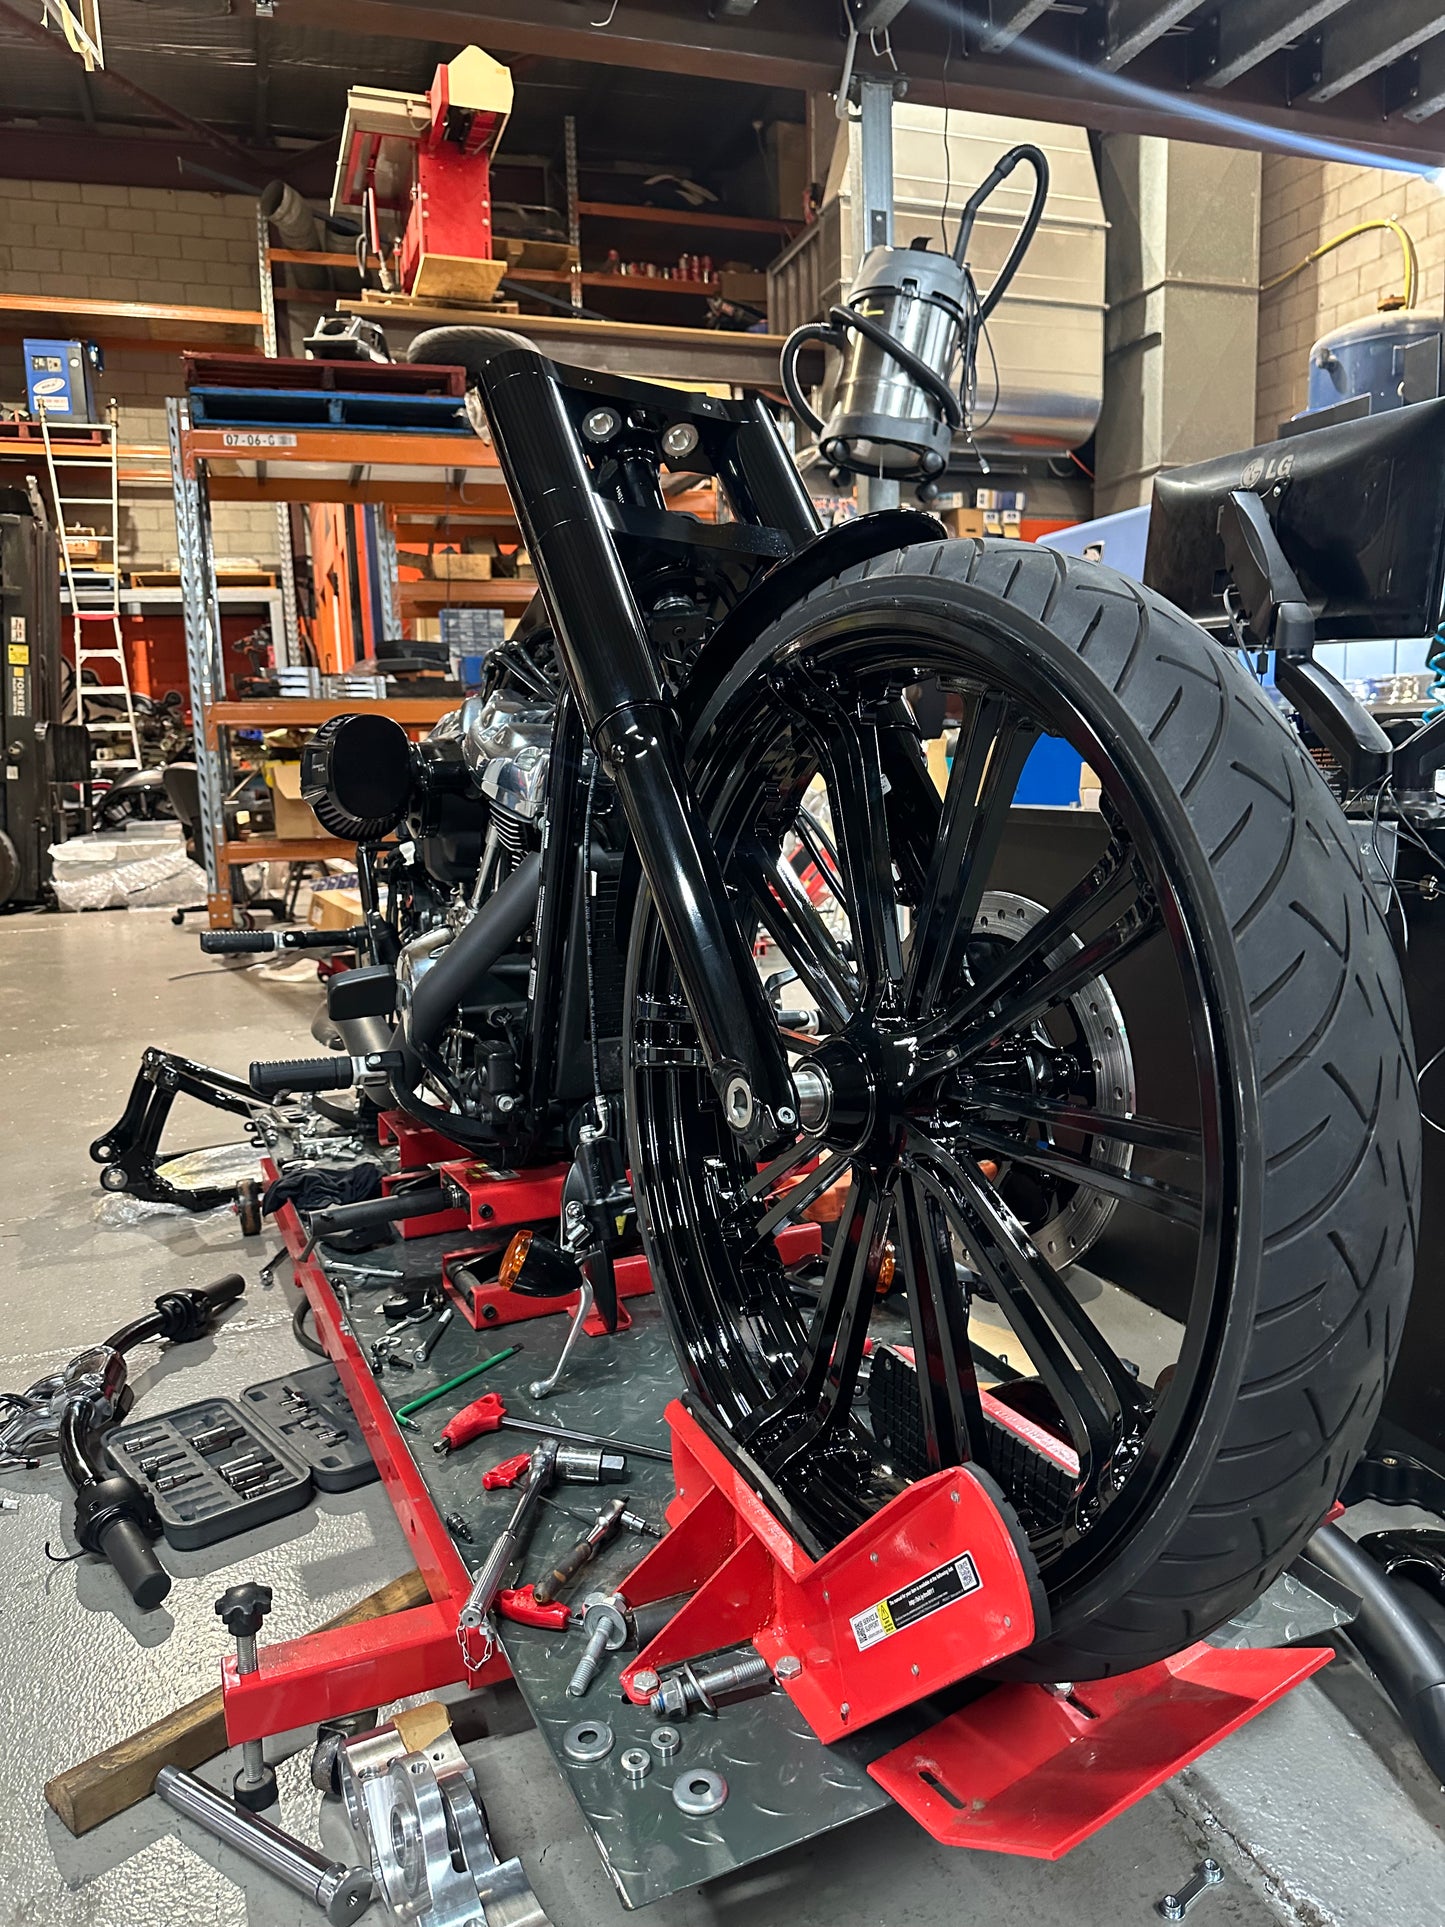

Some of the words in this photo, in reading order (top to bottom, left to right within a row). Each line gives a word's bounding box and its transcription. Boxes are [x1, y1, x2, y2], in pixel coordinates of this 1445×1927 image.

[1265, 454, 1294, 480] LG
[862, 1613, 875, 1625] SERVICE
[864, 1619, 879, 1632] SUPPORT
